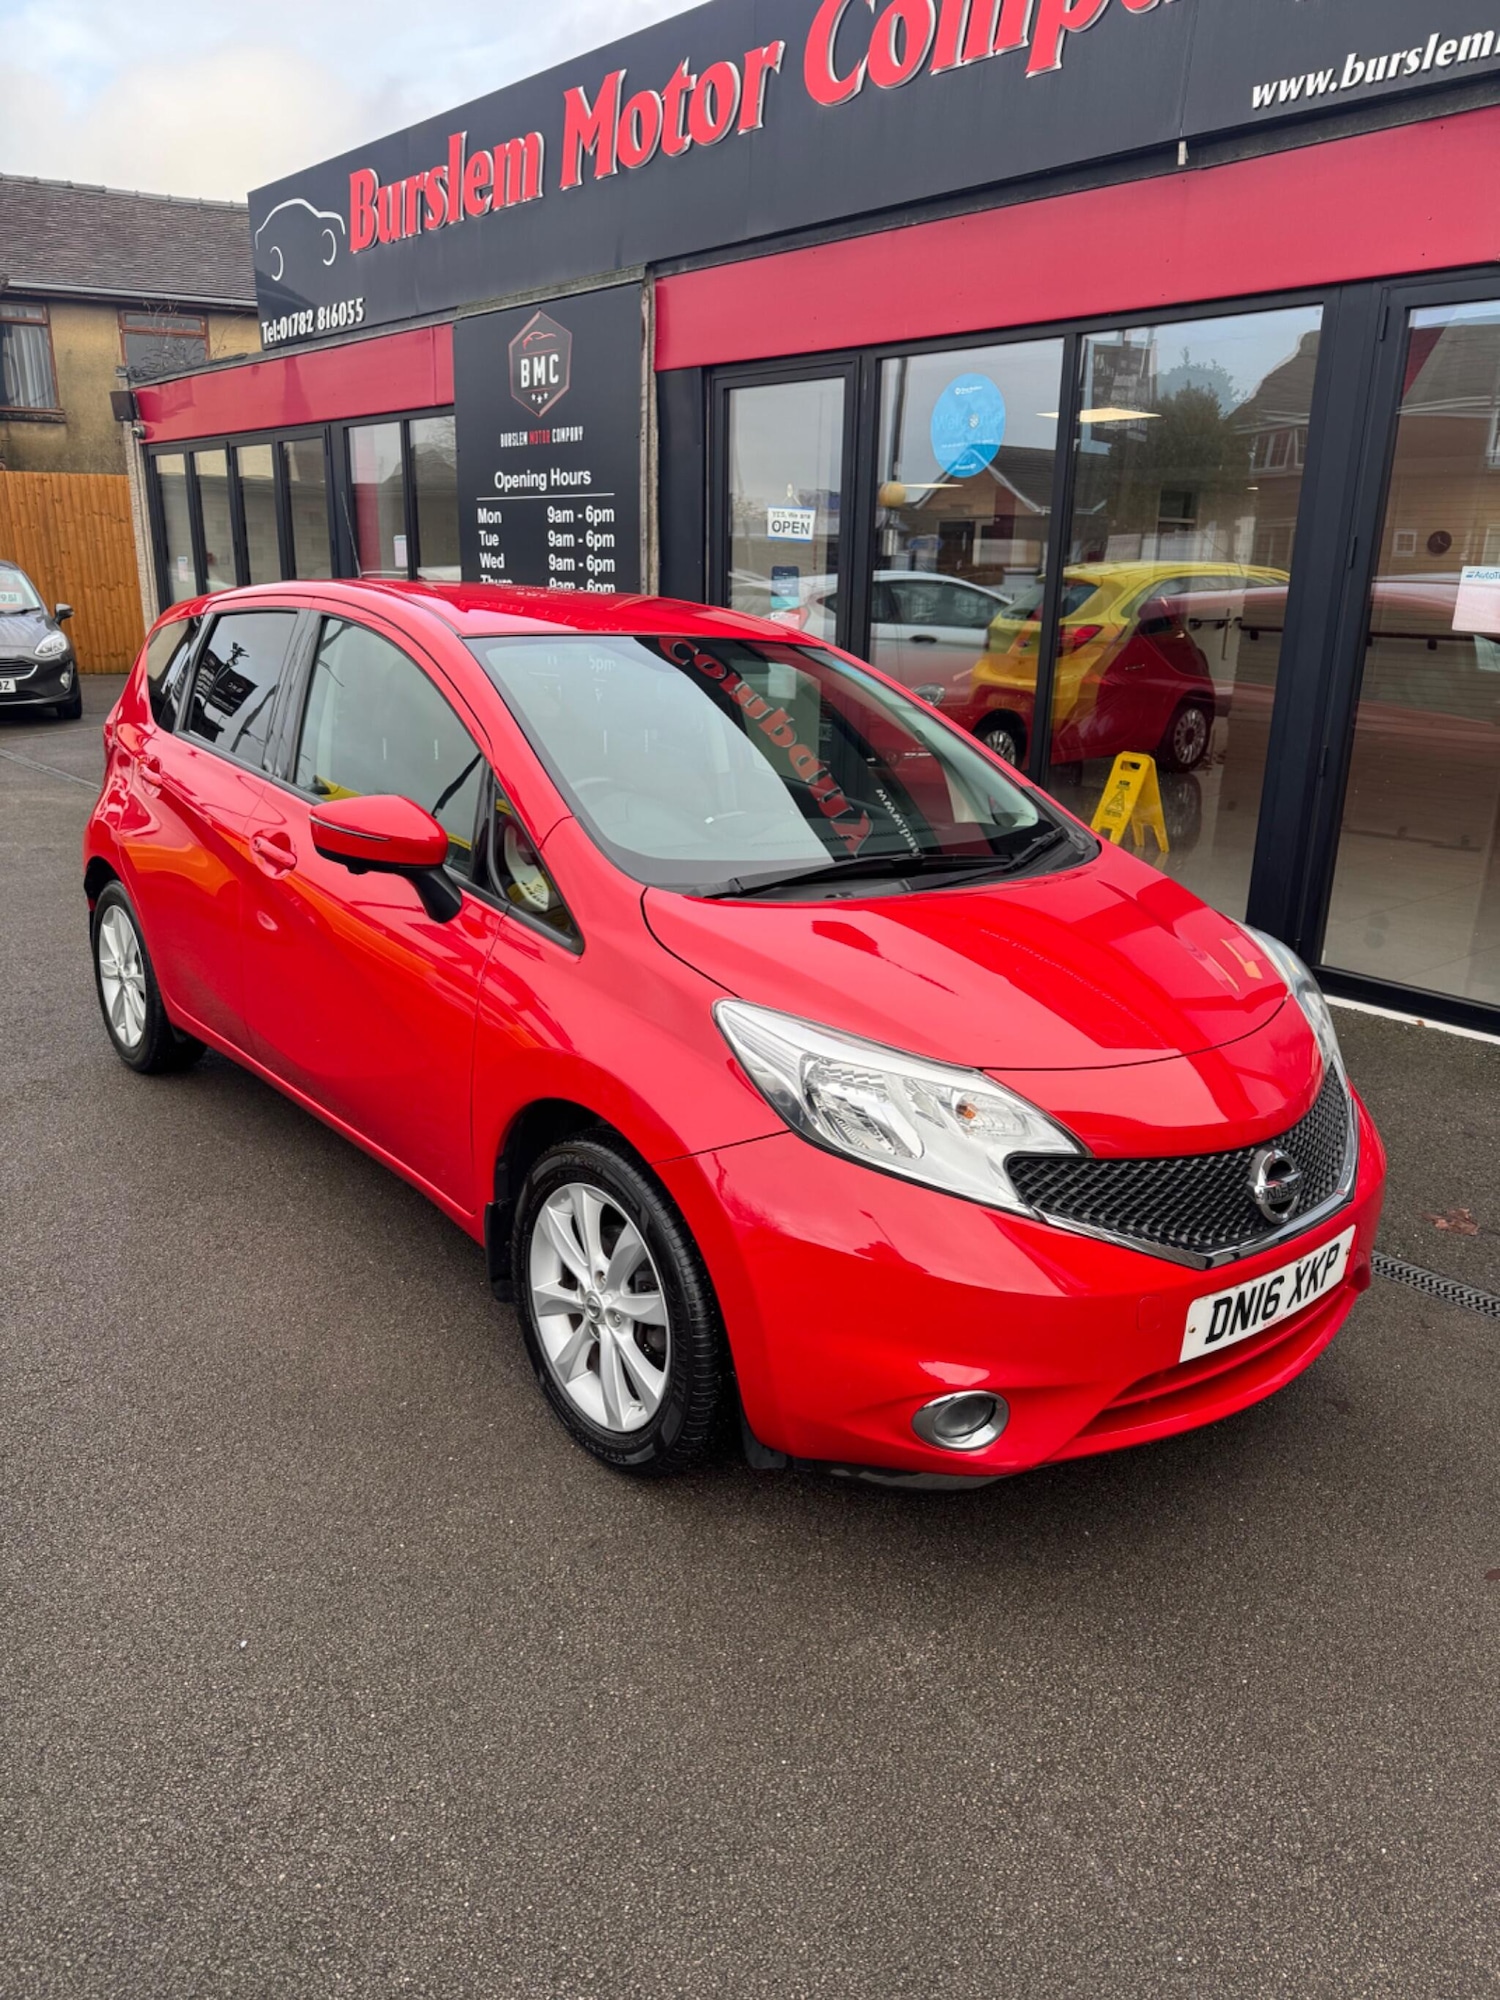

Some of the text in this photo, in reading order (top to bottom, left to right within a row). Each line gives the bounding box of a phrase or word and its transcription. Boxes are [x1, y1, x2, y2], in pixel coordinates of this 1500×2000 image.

[349, 0, 1172, 254] Burslem Motor Comp
[317, 298, 364, 331] 816055
[520, 354, 560, 388] BMC
[500, 426, 583, 448] BURSLEM MOTOR COMPANY
[494, 468, 592, 491] Opening Hours
[477, 508, 502, 523] Mon
[547, 506, 574, 523] 9am
[585, 505, 615, 526] 6pm
[478, 531, 499, 546] Tue
[771, 520, 811, 535] OPEN
[547, 530, 575, 547] 9am
[585, 530, 615, 551] 6pm
[479, 553, 505, 569] Wed
[548, 554, 575, 571] 9am
[586, 554, 615, 576] 6pm
[1204, 1242, 1340, 1344] DN16 XKP
